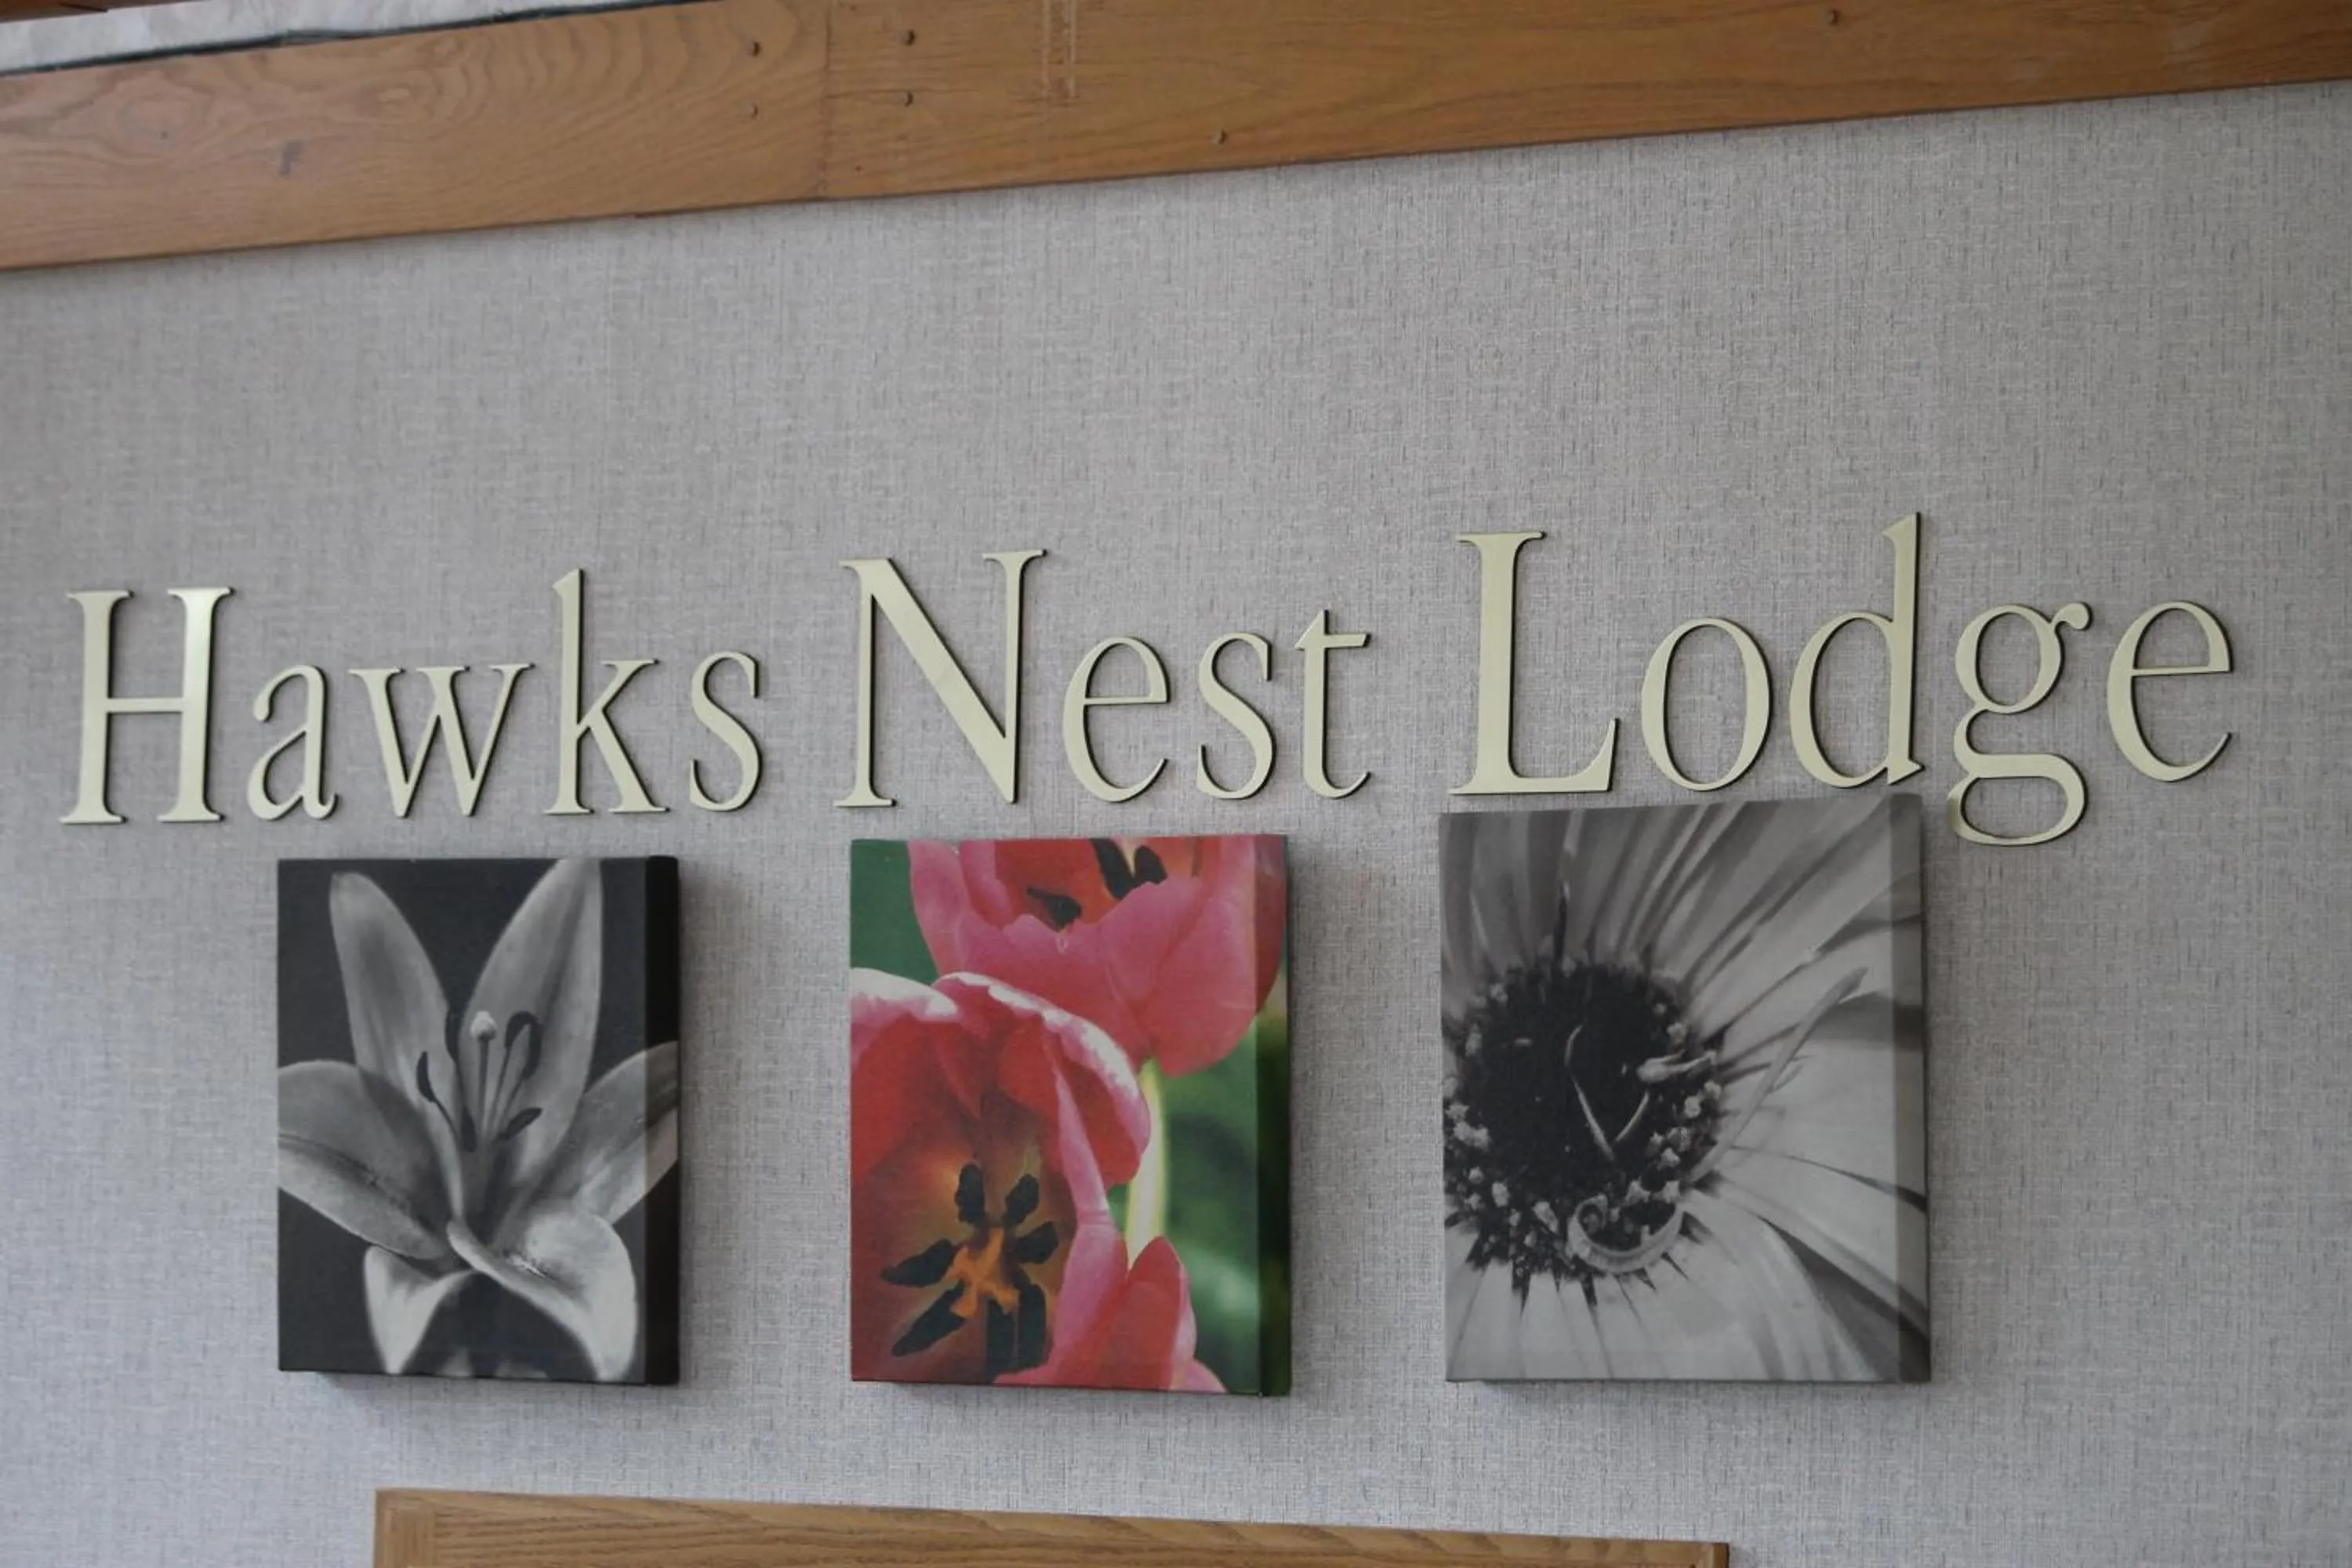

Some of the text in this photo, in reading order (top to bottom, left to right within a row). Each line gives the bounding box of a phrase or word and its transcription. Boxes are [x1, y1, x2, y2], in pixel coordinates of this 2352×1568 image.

[61, 511, 2234, 847] Hawks Nest Lodge
